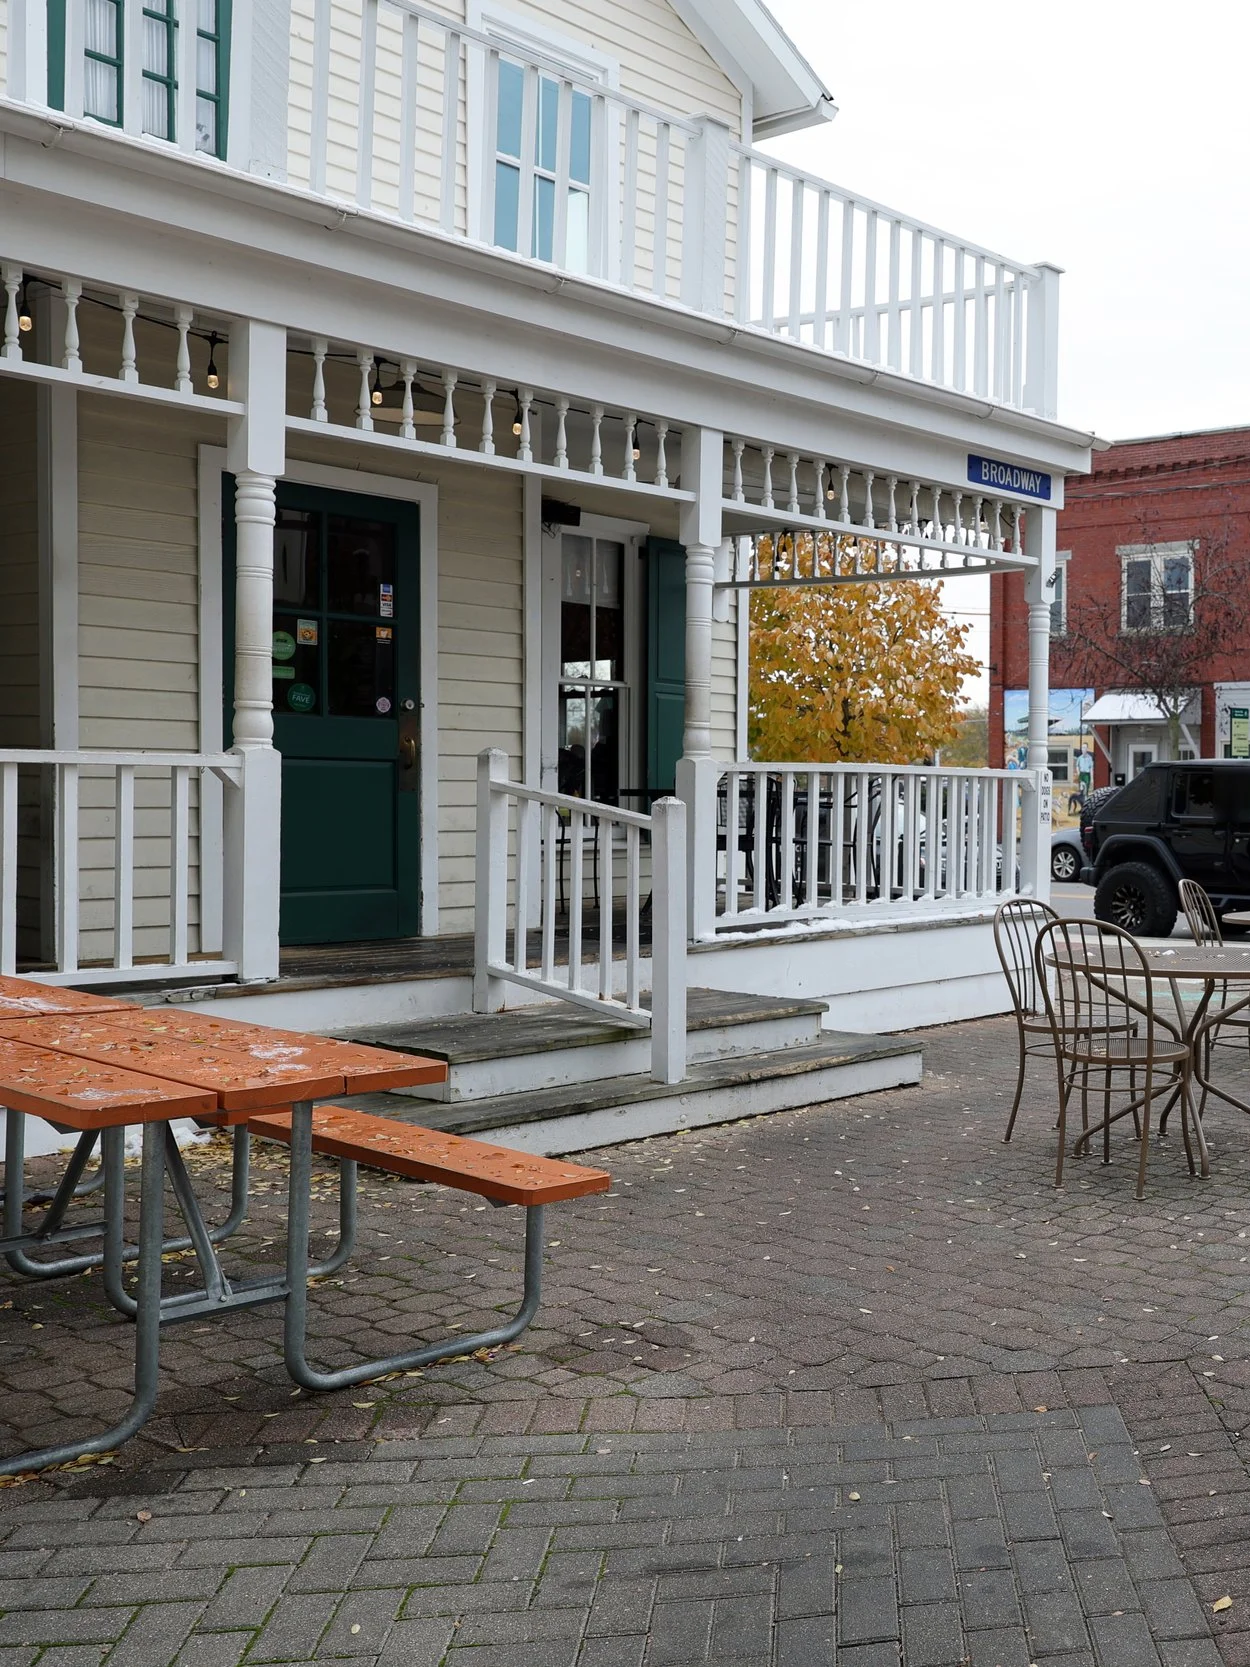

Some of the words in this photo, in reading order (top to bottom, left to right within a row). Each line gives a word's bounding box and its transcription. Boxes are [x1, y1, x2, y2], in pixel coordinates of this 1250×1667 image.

[981, 461, 1042, 494] BROADWAY
[291, 694, 311, 704] FAVE
[1044, 773, 1049, 782] NO
[1041, 786, 1051, 795] DOGS
[1043, 799, 1049, 808] ON
[1040, 812, 1050, 821] PATIO
